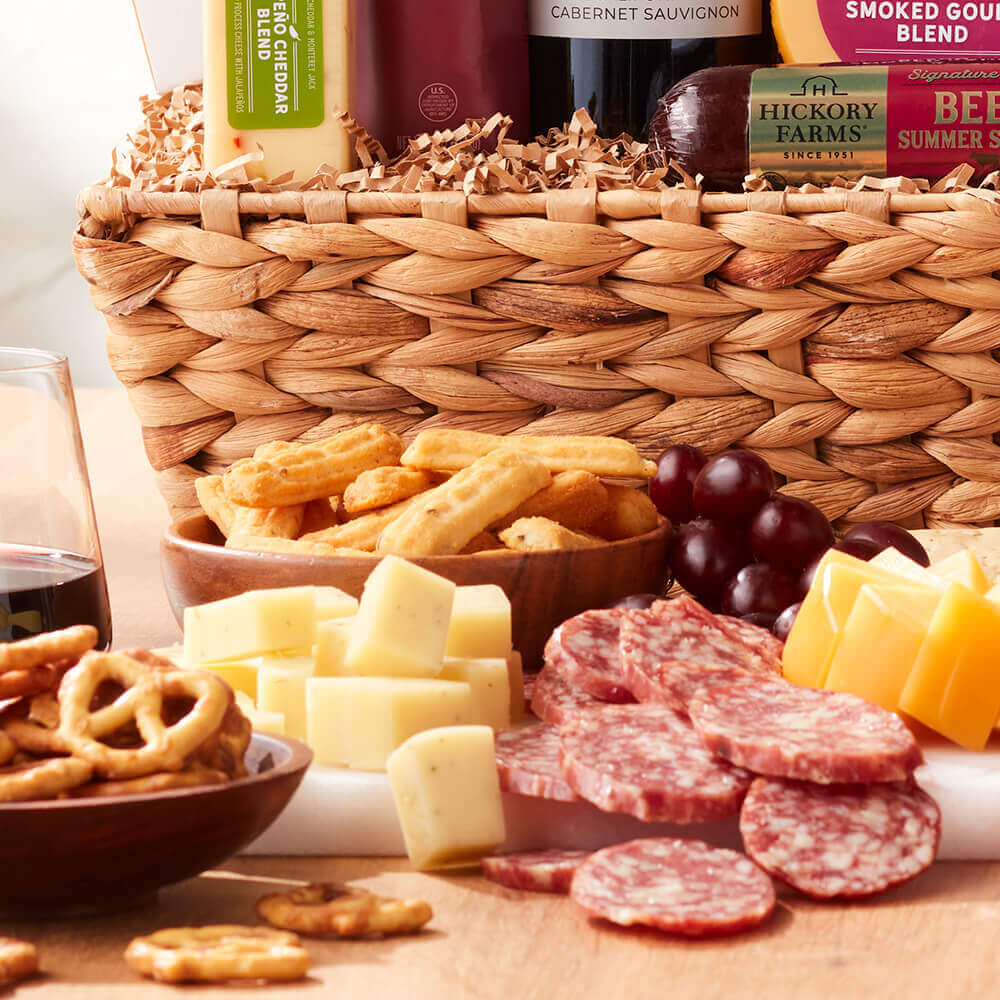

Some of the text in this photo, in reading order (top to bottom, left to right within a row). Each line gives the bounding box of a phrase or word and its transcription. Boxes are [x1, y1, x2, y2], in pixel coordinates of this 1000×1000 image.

[551, 5, 739, 21] CABERNET SAUVIGNON
[845, 0, 939, 21] SMOKED
[256, 8, 271, 60] BLEND
[896, 24, 969, 43] BLEND
[273, 40, 288, 114] CHEDDAR
[908, 67, 999, 83] Signature
[813, 84, 825, 96] H
[758, 102, 878, 121] HICKORY
[897, 129, 984, 150] SUMMER
[783, 151, 854, 160] SINCE 1951
